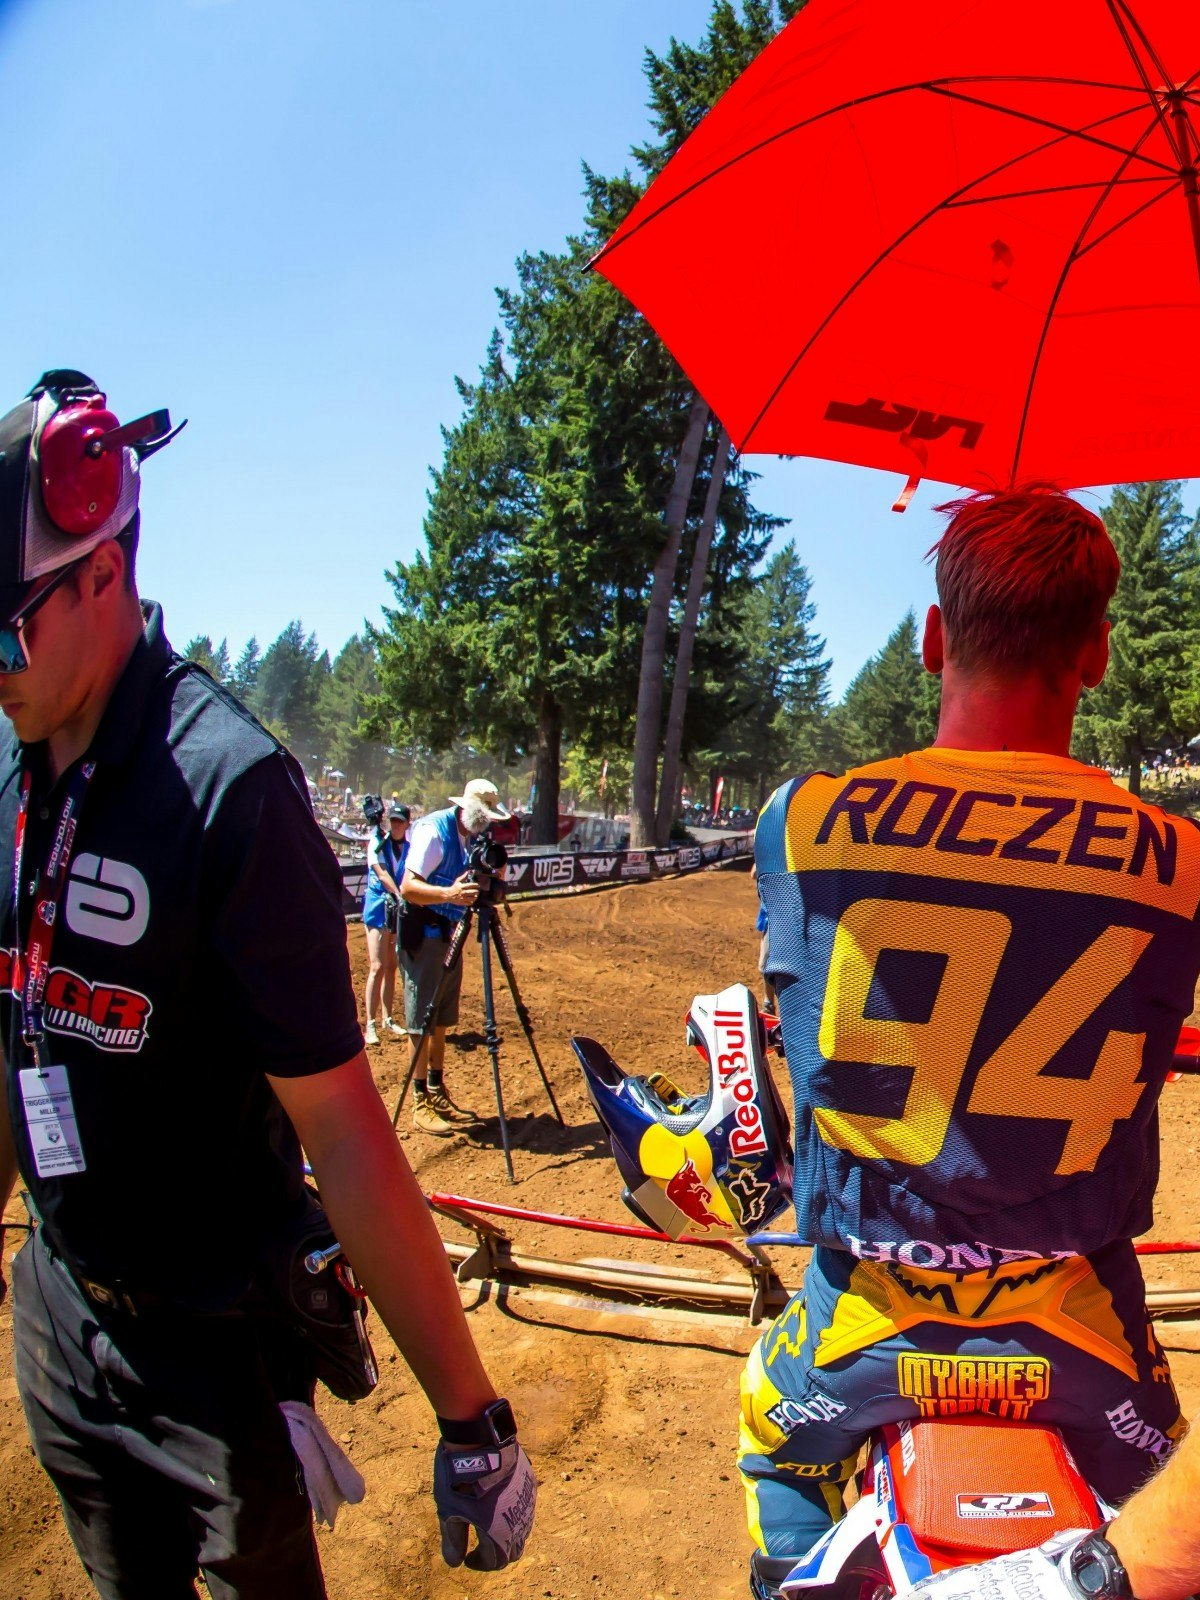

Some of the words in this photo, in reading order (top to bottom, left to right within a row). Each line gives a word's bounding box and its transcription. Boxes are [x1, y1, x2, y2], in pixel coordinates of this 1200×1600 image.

[46, 796, 74, 878] MOTOCROSS
[815, 778, 1178, 886] ROCZEN
[503, 863, 528, 881] LY
[533, 857, 575, 887] WPS
[579, 858, 617, 875] FLY
[75, 1014, 140, 1046] RACING
[713, 1009, 749, 1076] Bull
[812, 898, 1156, 1176] 94
[719, 1077, 768, 1157] Red
[904, 1359, 950, 1398] MY
[957, 1360, 1045, 1400] BIKES
[1105, 1400, 1174, 1460] HOND
[776, 1461, 837, 1478] FOX
